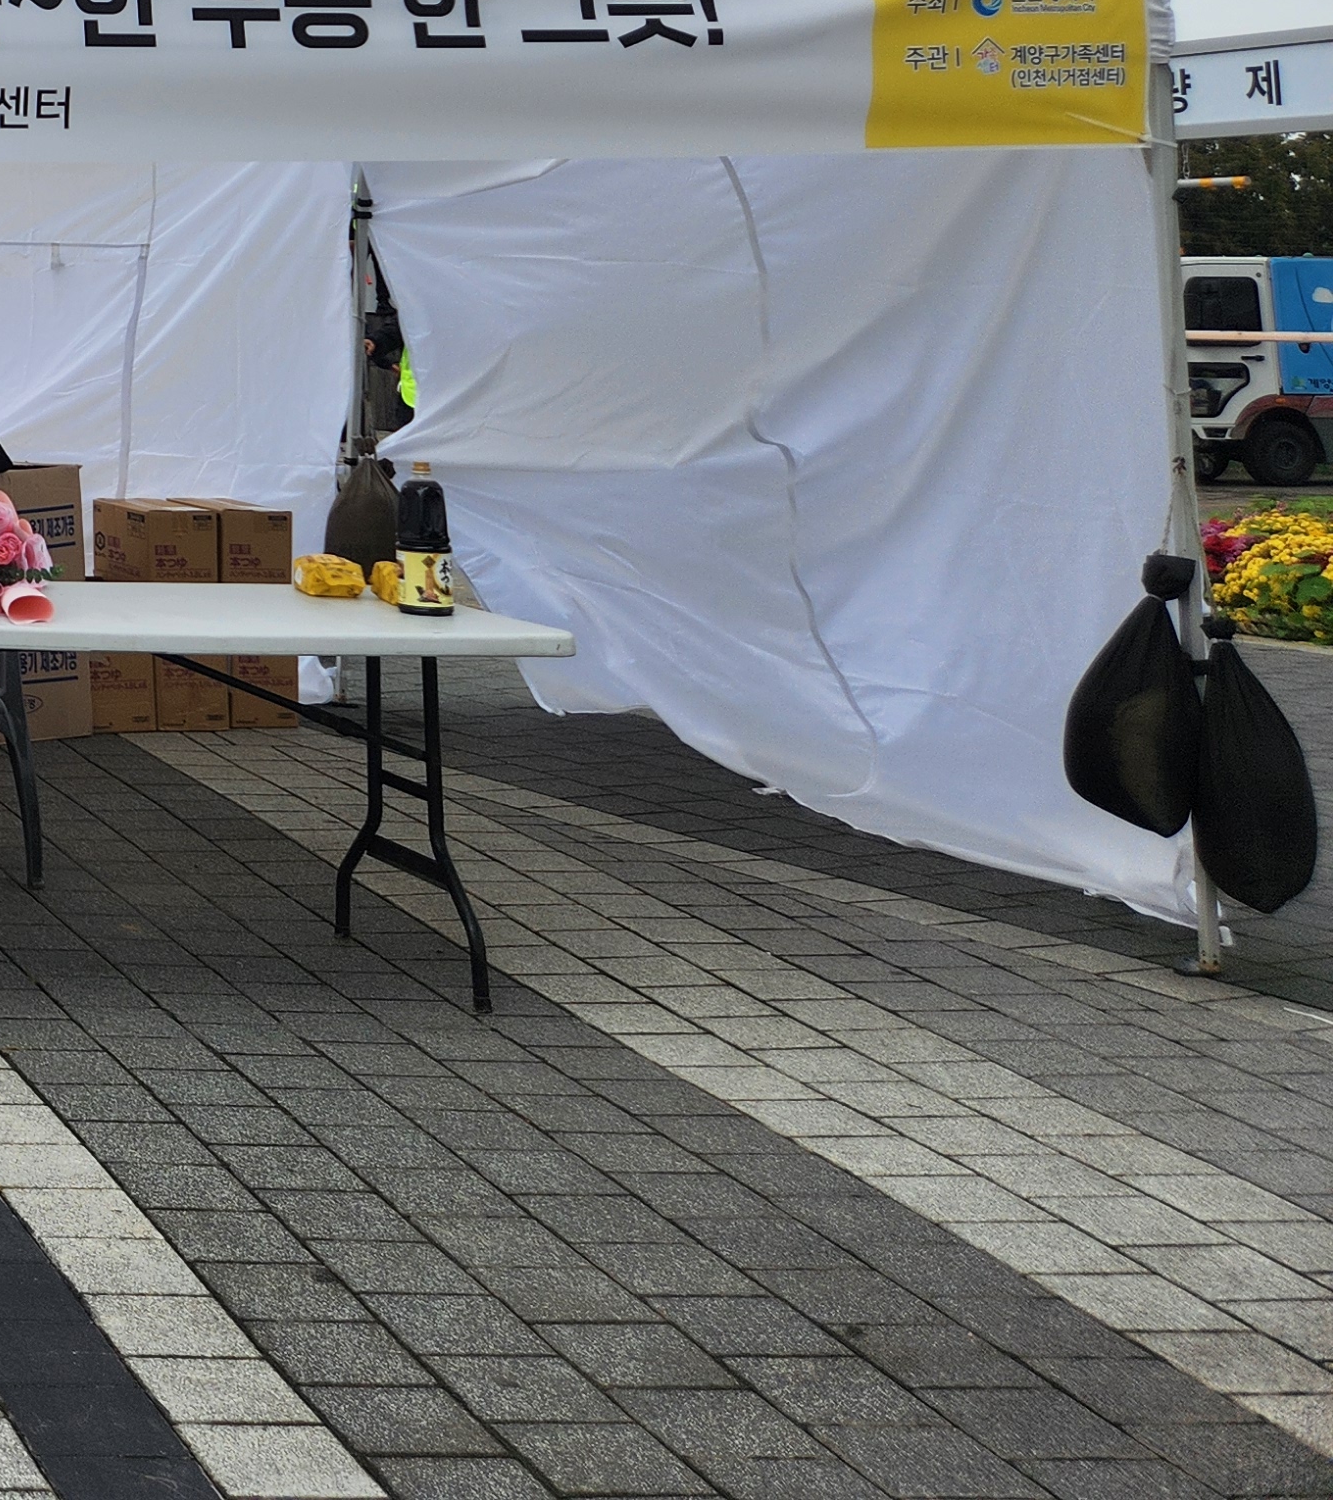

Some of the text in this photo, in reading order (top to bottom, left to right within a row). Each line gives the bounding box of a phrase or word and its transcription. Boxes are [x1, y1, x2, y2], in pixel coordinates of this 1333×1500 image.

[905, 45, 949, 71] 주관
[1010, 43, 1125, 65] 계양구가족센터
[1011, 67, 1126, 88] (인천시거점센터)
